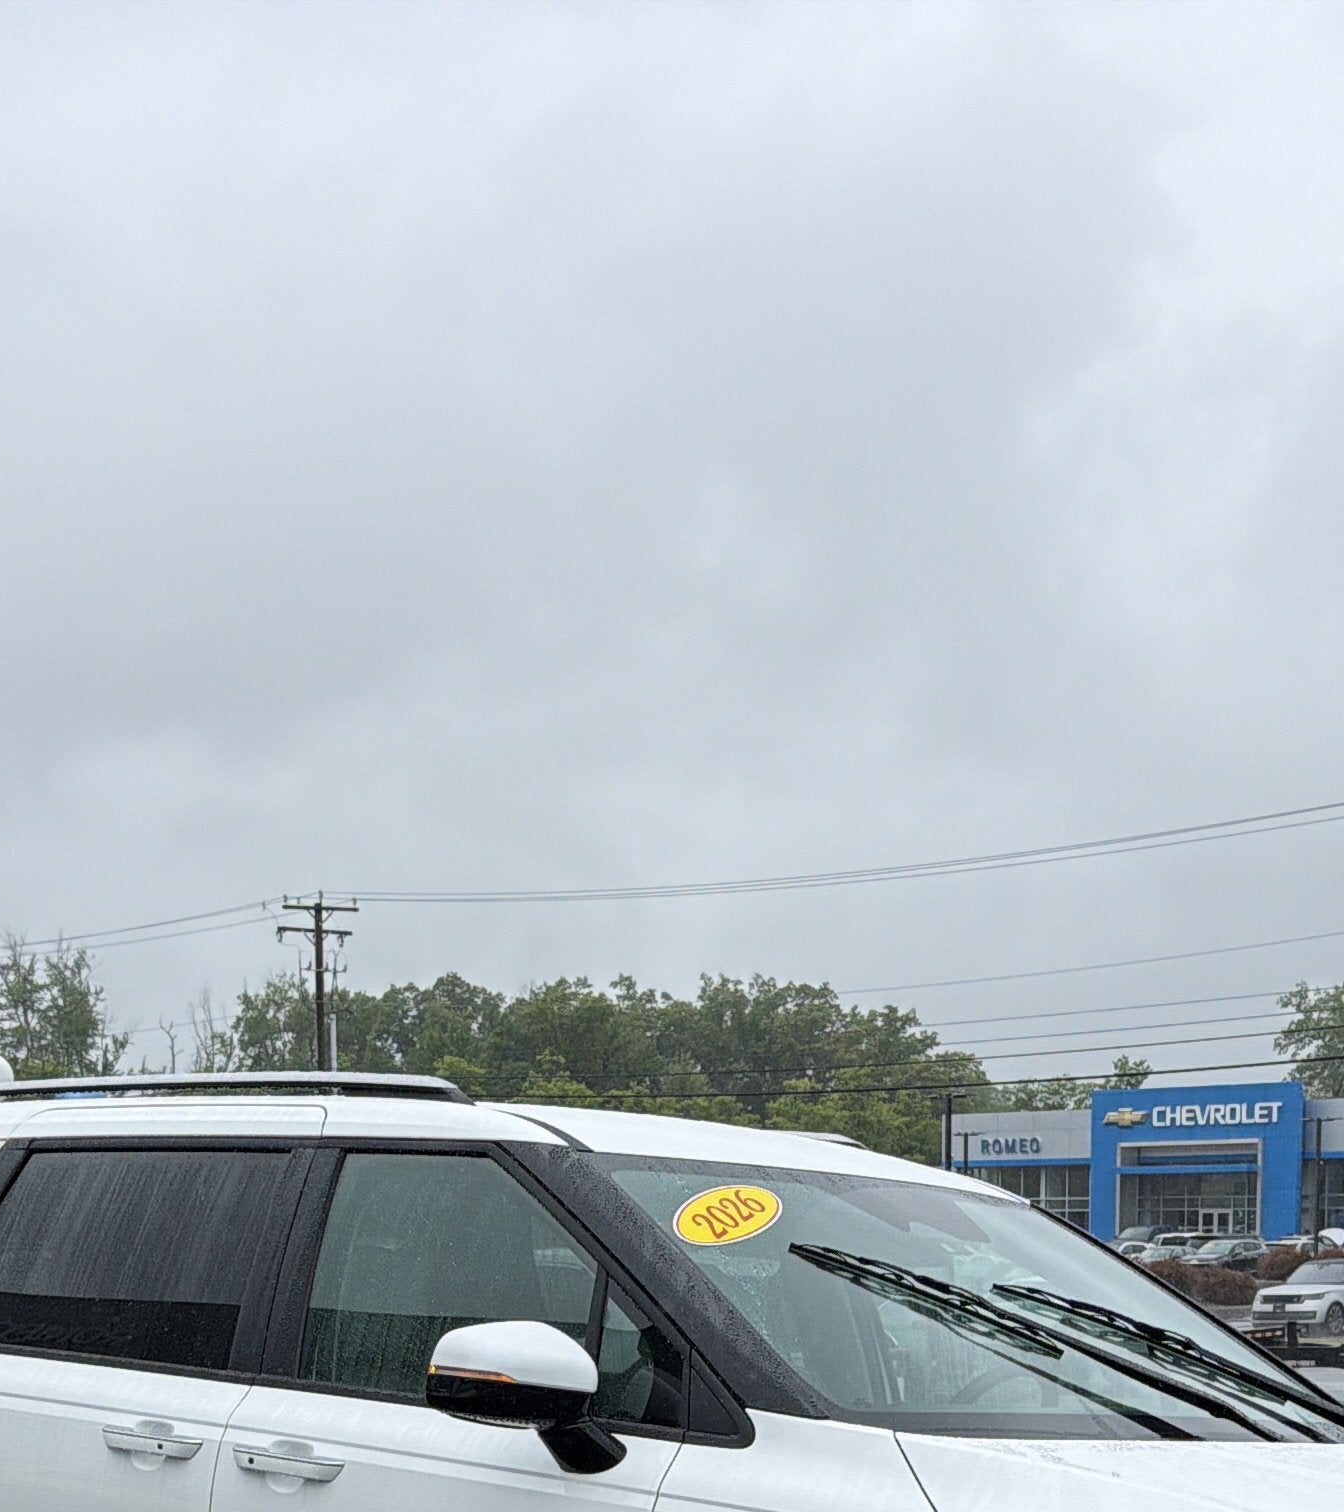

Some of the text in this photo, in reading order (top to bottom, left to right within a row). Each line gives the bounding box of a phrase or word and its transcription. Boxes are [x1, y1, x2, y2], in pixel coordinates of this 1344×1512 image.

[1152, 1102, 1283, 1127] CHEVROLET
[980, 1137, 1041, 1156] ROMEO
[691, 1189, 766, 1240] 2026
